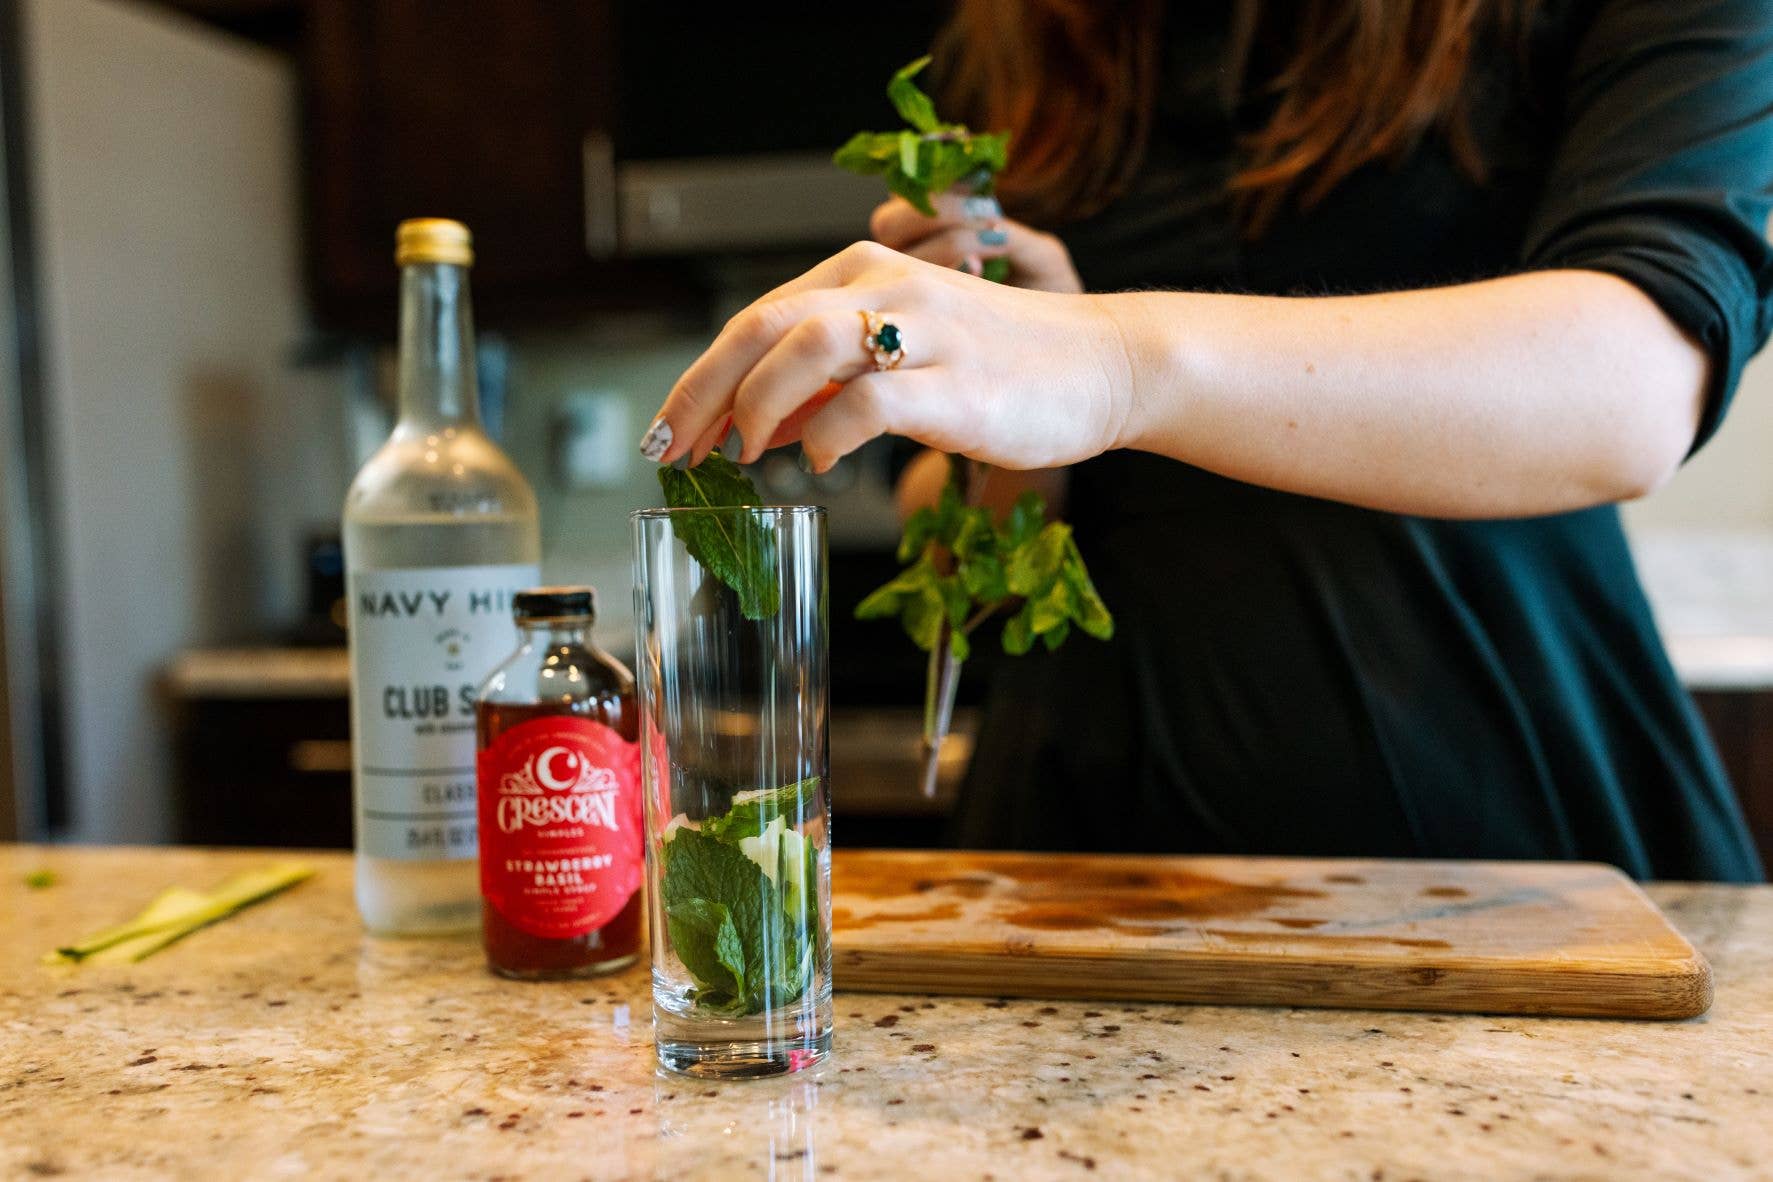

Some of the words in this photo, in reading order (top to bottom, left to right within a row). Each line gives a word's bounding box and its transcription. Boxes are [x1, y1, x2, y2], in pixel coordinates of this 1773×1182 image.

[360, 590, 451, 617] NAVY
[383, 684, 449, 719] CLUB
[505, 853, 614, 873] STRAWBERRY
[534, 871, 584, 887] BASIL
